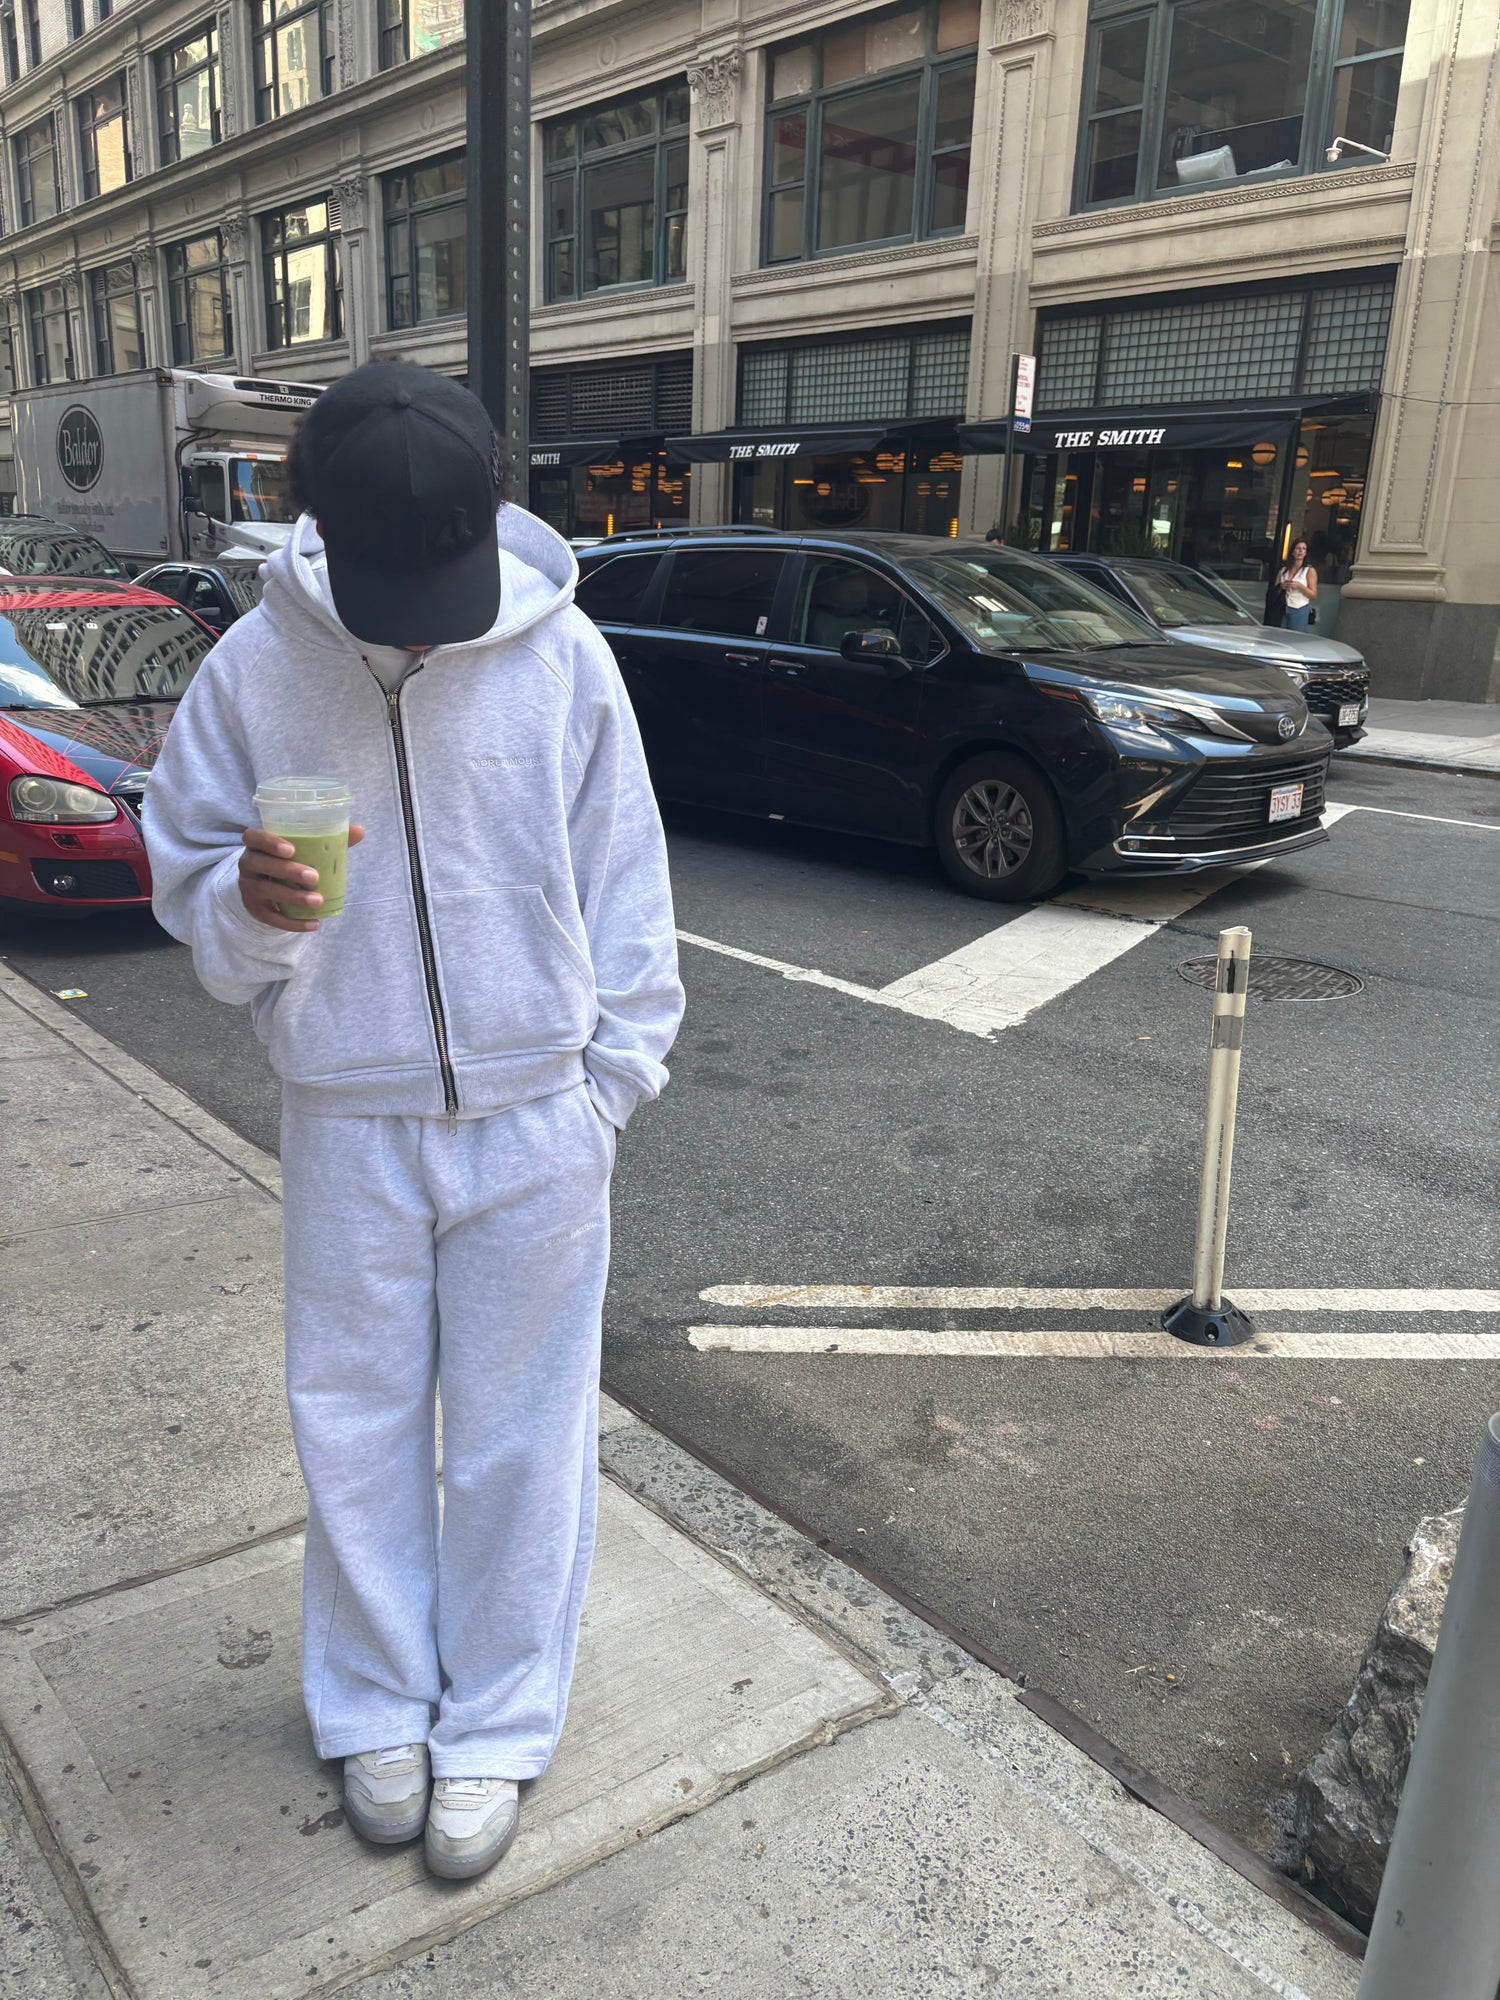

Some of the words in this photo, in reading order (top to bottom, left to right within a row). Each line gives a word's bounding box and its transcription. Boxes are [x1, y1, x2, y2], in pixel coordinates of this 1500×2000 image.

[259, 394, 293, 404] THERMO
[293, 398, 312, 406] KING
[1055, 431, 1094, 448] THE
[1097, 429, 1166, 446] SMITH
[62, 427, 98, 467] Baldor
[729, 445, 755, 459] THE
[756, 443, 800, 457] SMITH
[531, 453, 561, 465] SMITH
